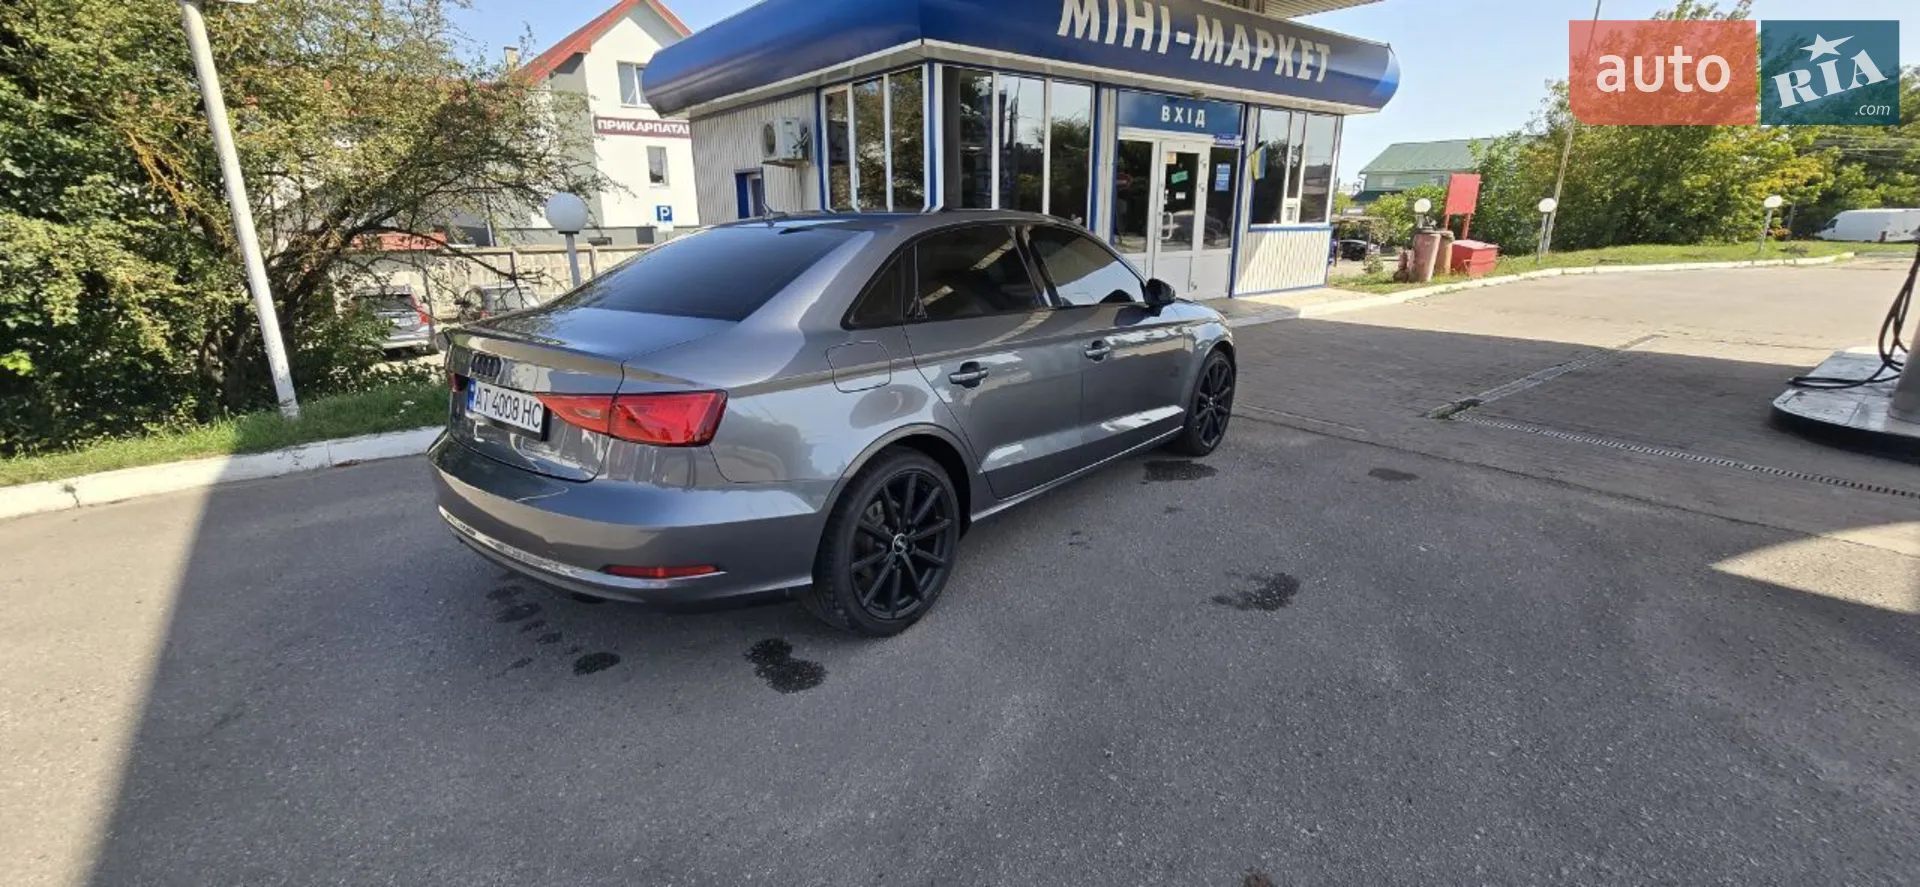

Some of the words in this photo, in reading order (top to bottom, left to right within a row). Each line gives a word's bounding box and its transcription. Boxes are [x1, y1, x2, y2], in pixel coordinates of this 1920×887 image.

[1057, 0, 1330, 82] МІНІ-МАРКЕТ
[1161, 105, 1205, 128] ВХІД
[660, 207, 670, 221] P
[475, 387, 491, 411] AT
[492, 391, 519, 421] 4008
[521, 399, 542, 428] HC
